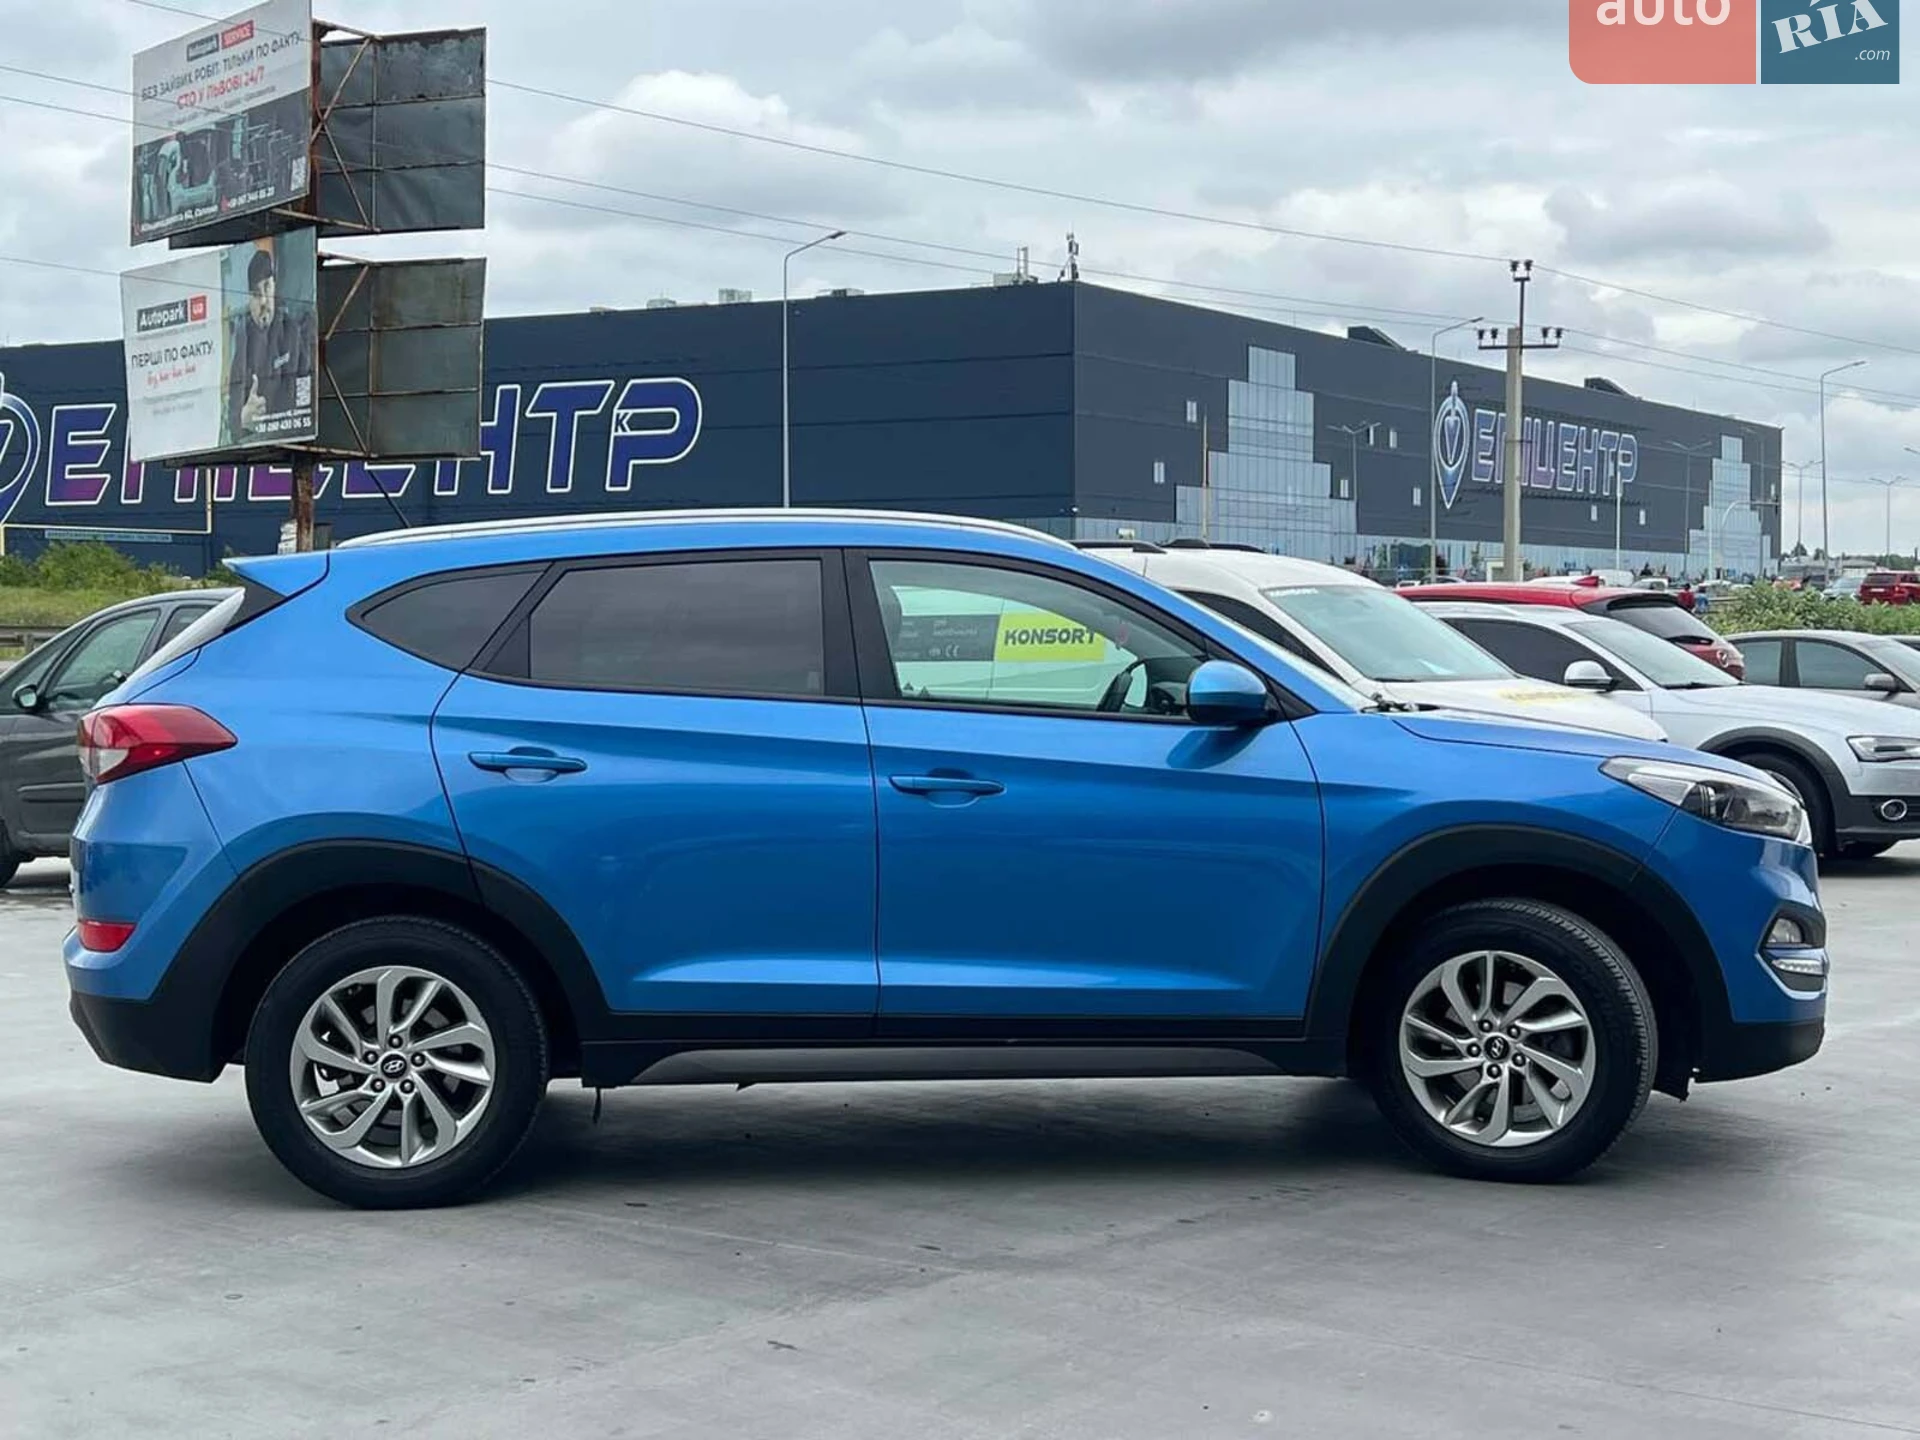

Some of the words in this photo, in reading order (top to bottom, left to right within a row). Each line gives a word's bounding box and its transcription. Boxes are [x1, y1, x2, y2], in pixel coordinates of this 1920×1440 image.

[142, 87, 157, 101] БЕЗ
[159, 72, 193, 95] ЗАЙВИХ
[222, 49, 254, 72] ТІЛЬКИ
[256, 42, 269, 59] ПО
[176, 91, 197, 110] СТО
[206, 75, 243, 101] ЛЬВОВІ
[140, 303, 185, 327] Autopark
[131, 350, 163, 368] ПЕРШІ
[164, 347, 178, 363] ПО
[1004, 628, 1096, 646] KONSORT
